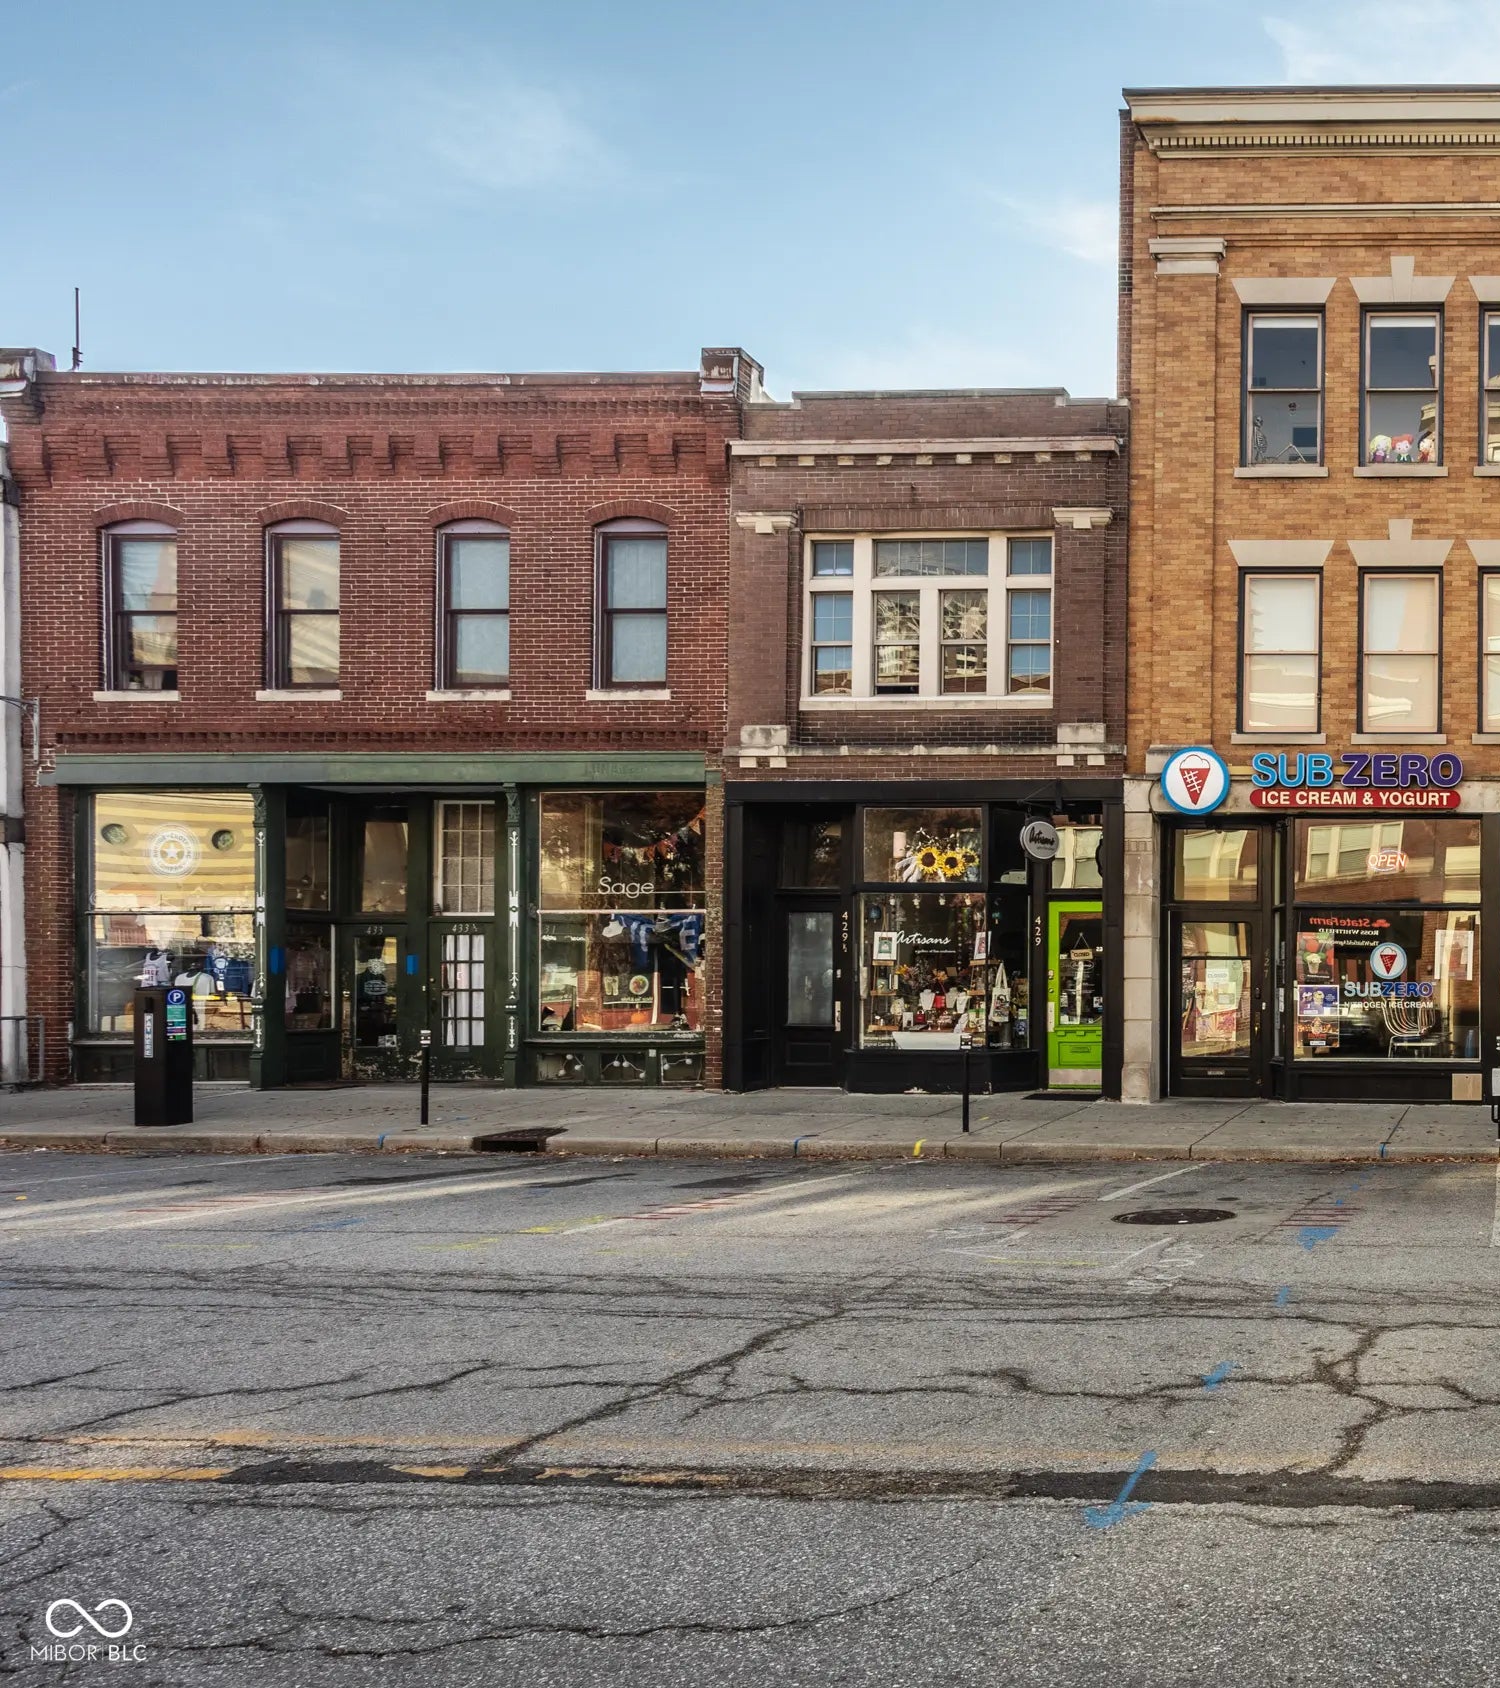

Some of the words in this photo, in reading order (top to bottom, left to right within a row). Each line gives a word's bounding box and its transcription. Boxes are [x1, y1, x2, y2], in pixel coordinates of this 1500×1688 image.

[1251, 752, 1334, 787] SUB
[1340, 752, 1463, 787] ZERO
[1262, 791, 1290, 805] ICE
[1296, 791, 1357, 805] CREAM
[1362, 791, 1373, 805] &
[1379, 791, 1450, 806] YOGURT
[1368, 853, 1407, 868] OPEN
[597, 876, 655, 899] Sage
[366, 925, 384, 935] 433
[452, 923, 470, 933] 433
[895, 930, 952, 945] Artisans
[1344, 1001, 1387, 1009] NITROGEN
[1389, 1001, 1403, 1009] ICE
[1404, 1001, 1434, 1009] CREAM
